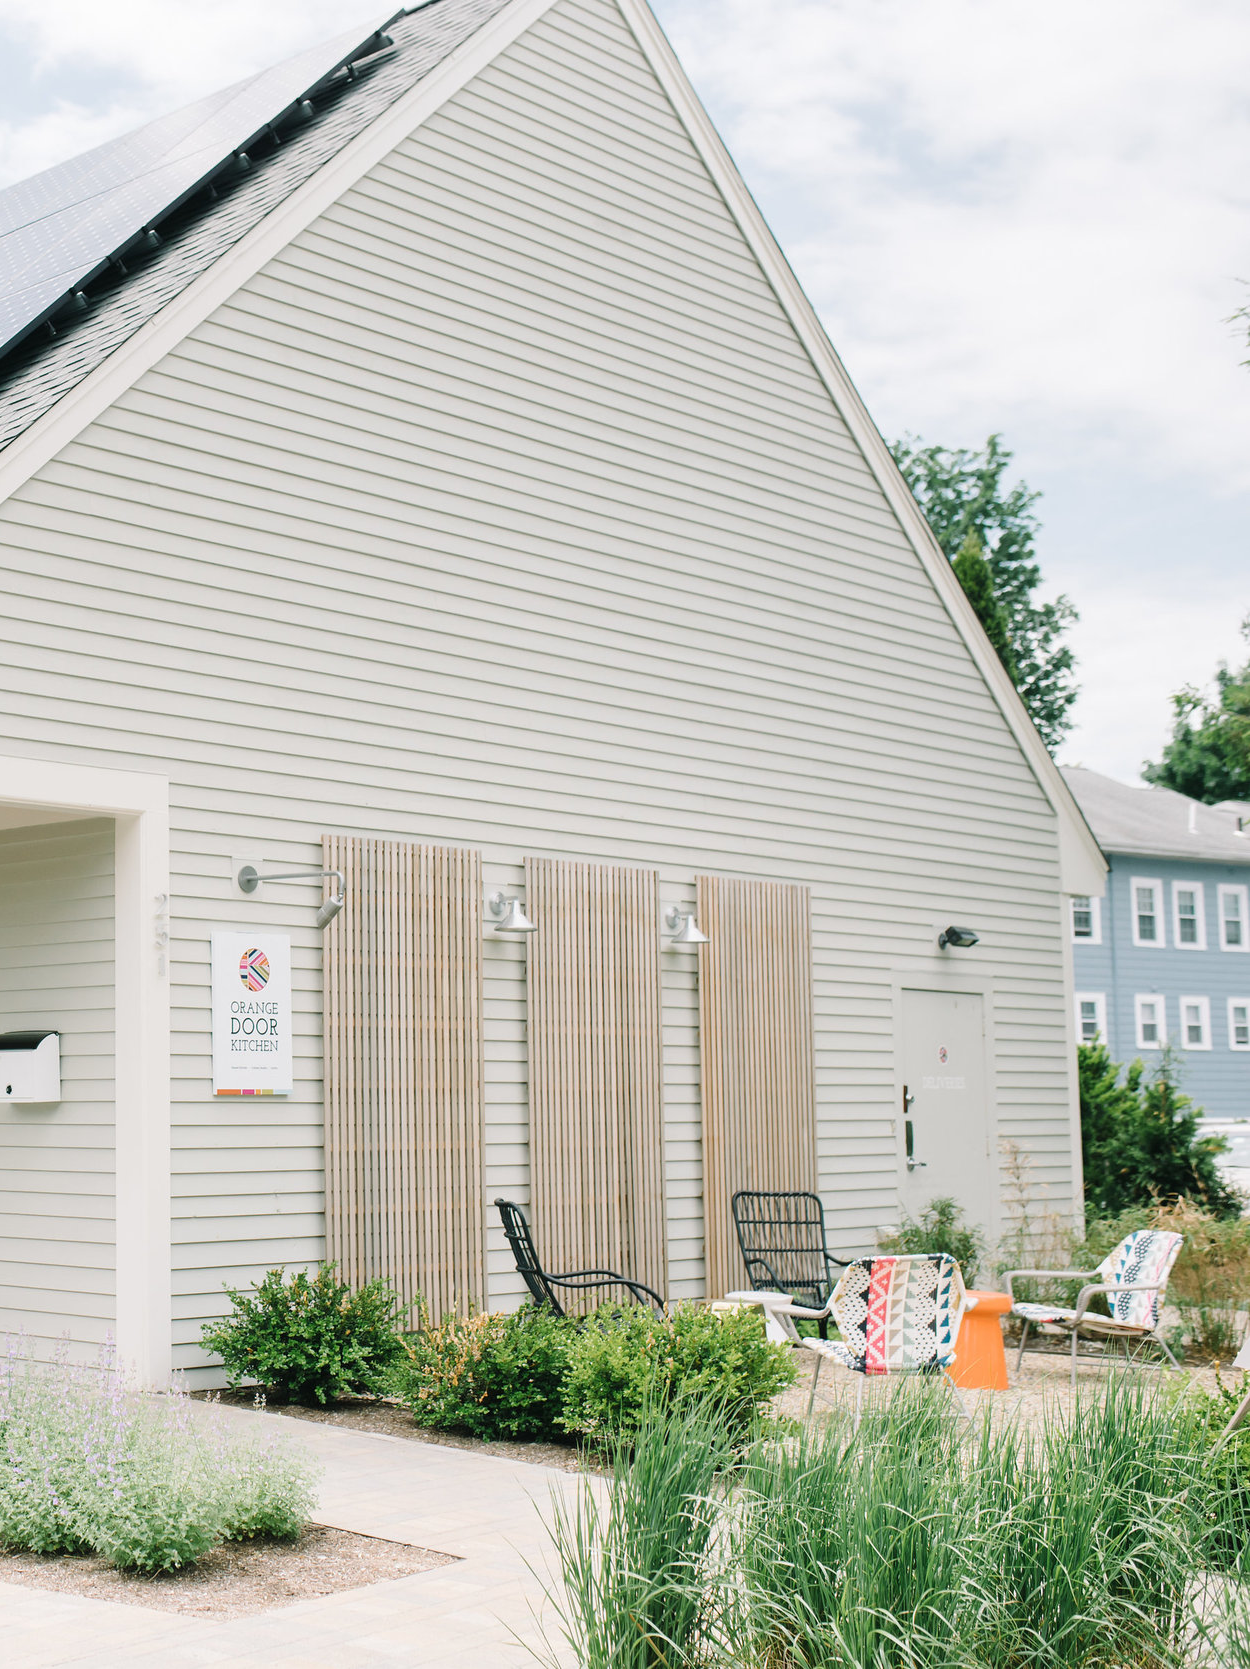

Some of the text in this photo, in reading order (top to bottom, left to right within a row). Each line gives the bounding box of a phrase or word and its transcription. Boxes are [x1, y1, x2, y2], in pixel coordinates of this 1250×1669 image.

[230, 1001, 279, 1014] ORANGE
[230, 1017, 279, 1036] DOOR
[230, 1039, 279, 1052] KITCHEN
